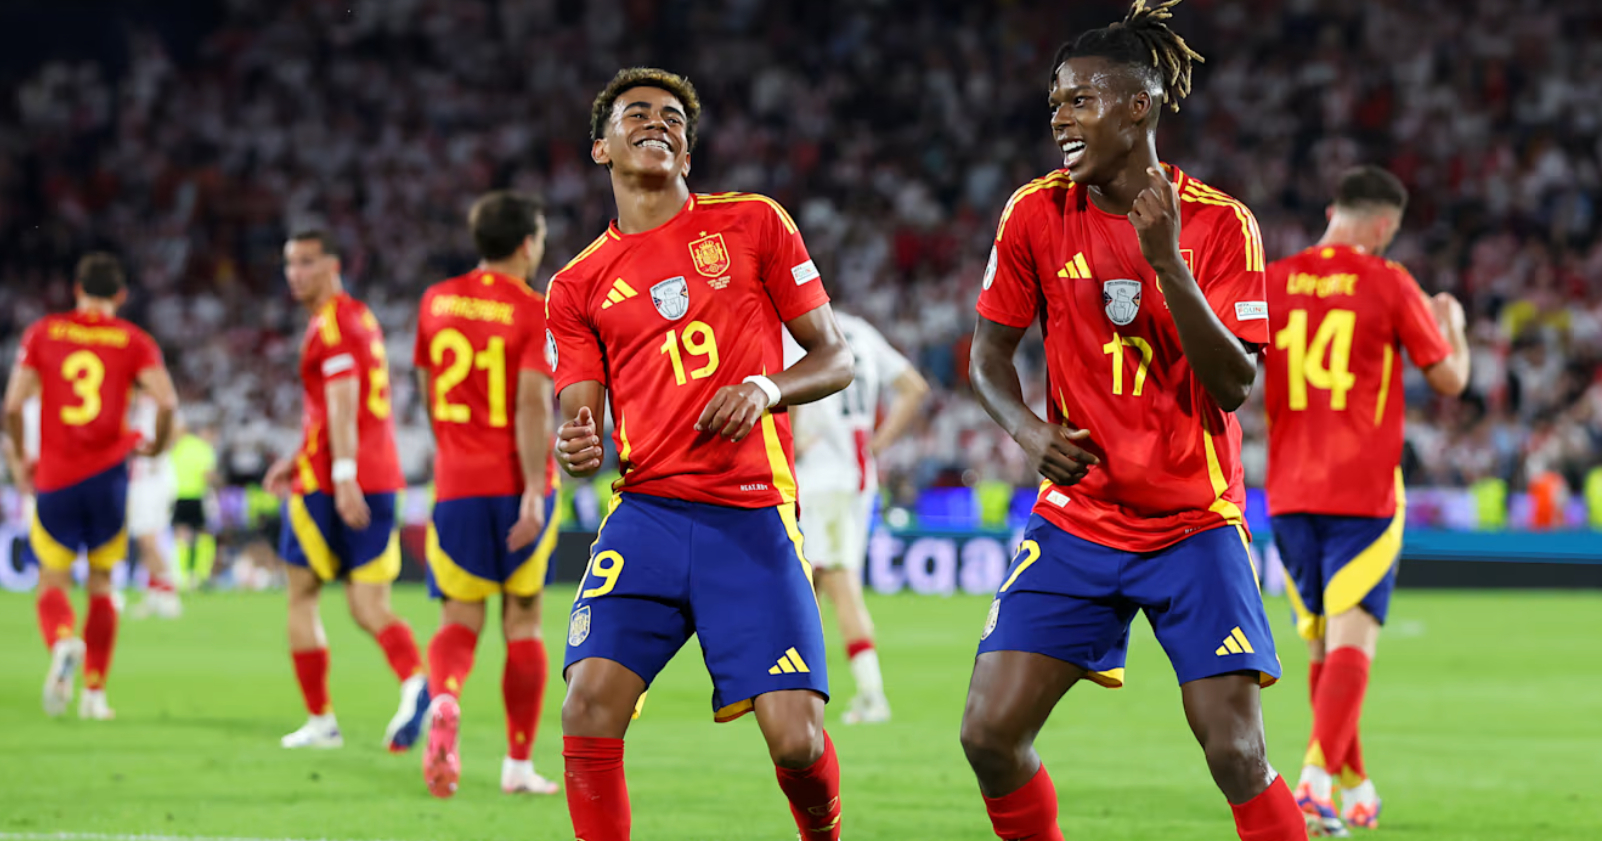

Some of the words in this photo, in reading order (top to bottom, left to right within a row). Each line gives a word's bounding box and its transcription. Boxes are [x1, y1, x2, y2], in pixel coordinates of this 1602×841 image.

[60, 350, 106, 426] 3
[430, 328, 508, 427] 21
[660, 320, 720, 386] 19
[1103, 332, 1154, 397] 17
[1275, 308, 1357, 411] 14
